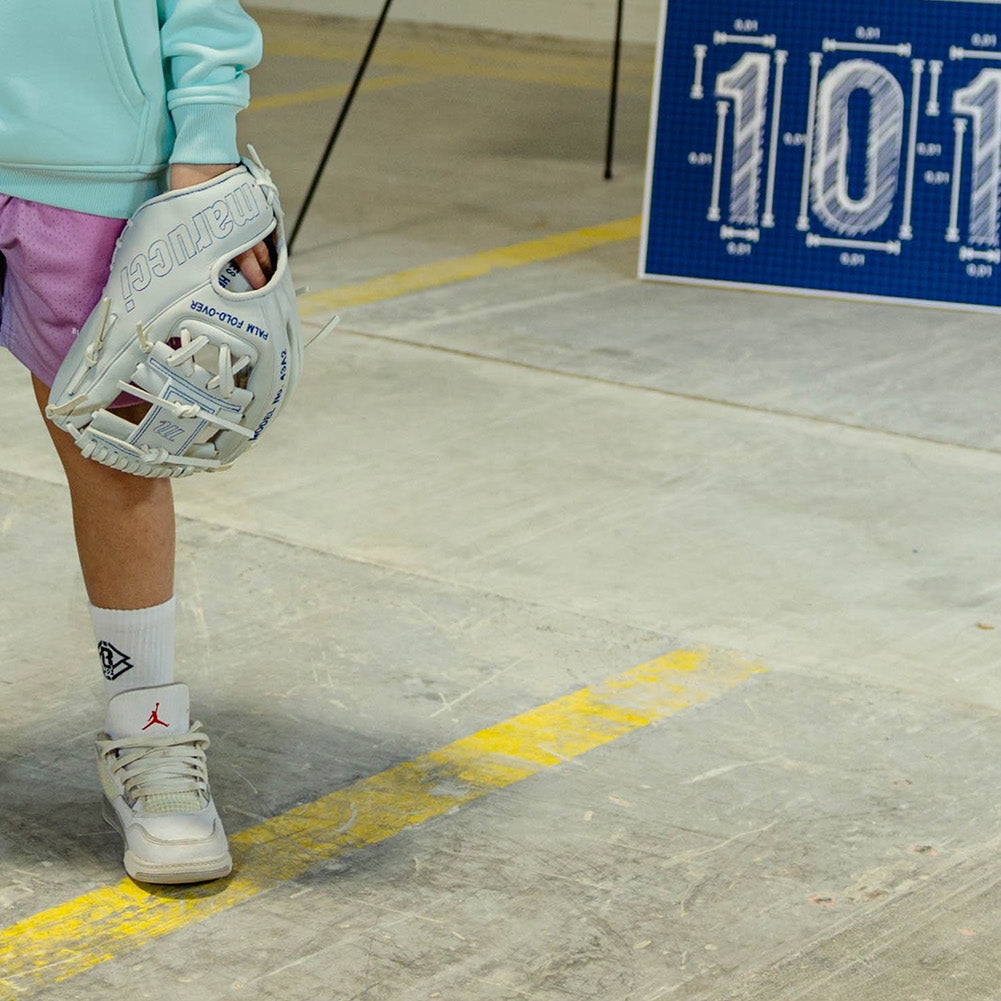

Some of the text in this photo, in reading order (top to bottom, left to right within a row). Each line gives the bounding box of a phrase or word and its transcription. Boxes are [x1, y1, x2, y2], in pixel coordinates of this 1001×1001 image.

[714, 51, 1001, 247] 101
[120, 182, 260, 313] marucci
[190, 299, 269, 341] PALM FOLD-OVER
